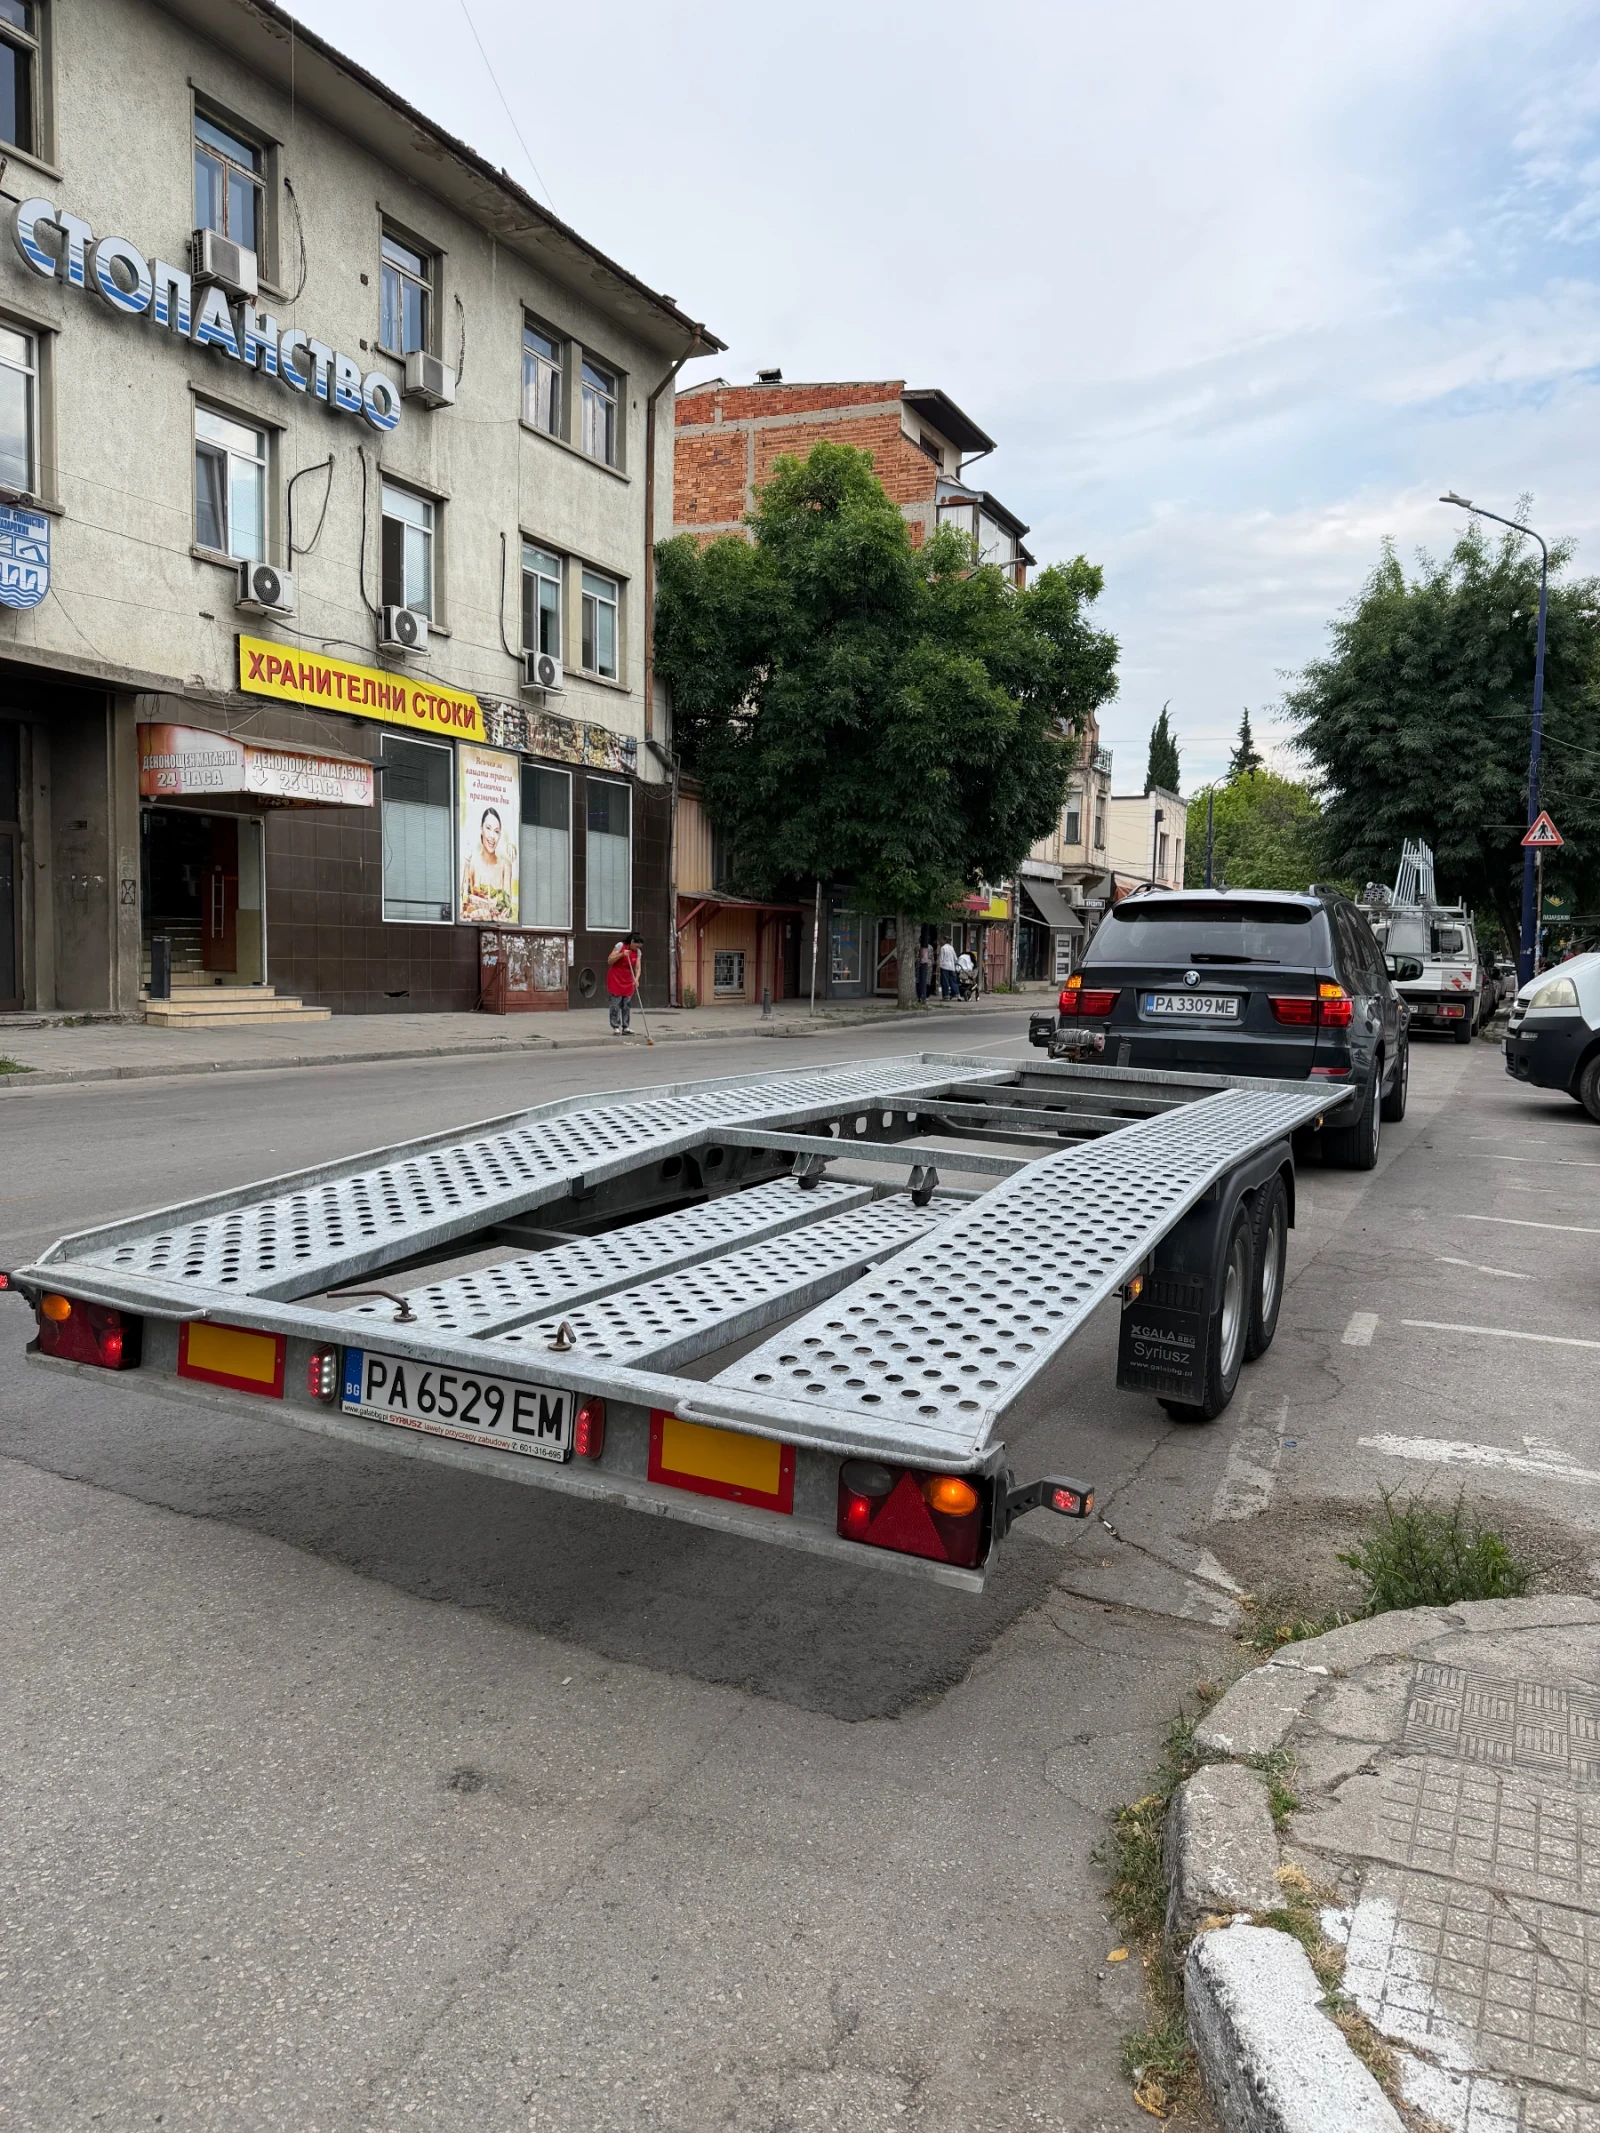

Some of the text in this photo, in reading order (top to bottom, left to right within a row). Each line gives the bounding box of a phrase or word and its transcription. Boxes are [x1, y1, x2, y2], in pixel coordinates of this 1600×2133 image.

[11, 197, 402, 432] СТОПАНСТВО
[248, 650, 476, 730] ХРАНИТЕЛНИ СТОКИ
[142, 750, 238, 771] ДЕНОНОЩЕН МАГАЗИН
[252, 751, 368, 783] ДЕНОНОЩЕН МАГАЗИН
[157, 769, 223, 787] 24 ЧАСА
[279, 773, 344, 797] 24 ЧАСА
[1155, 997, 1235, 1014] PA 3309 ME
[1178, 1335, 1196, 1344] BBG
[1134, 1341, 1190, 1364] Syriusz
[1130, 1361, 1193, 1377] www.galabbg.pl
[346, 1382, 360, 1396] BG
[366, 1359, 564, 1442] PA 6529 EM
[344, 1404, 562, 1460] www.galabbg.pl SYRIUSZ lawety przyczepy zabudowy 601-316-695
